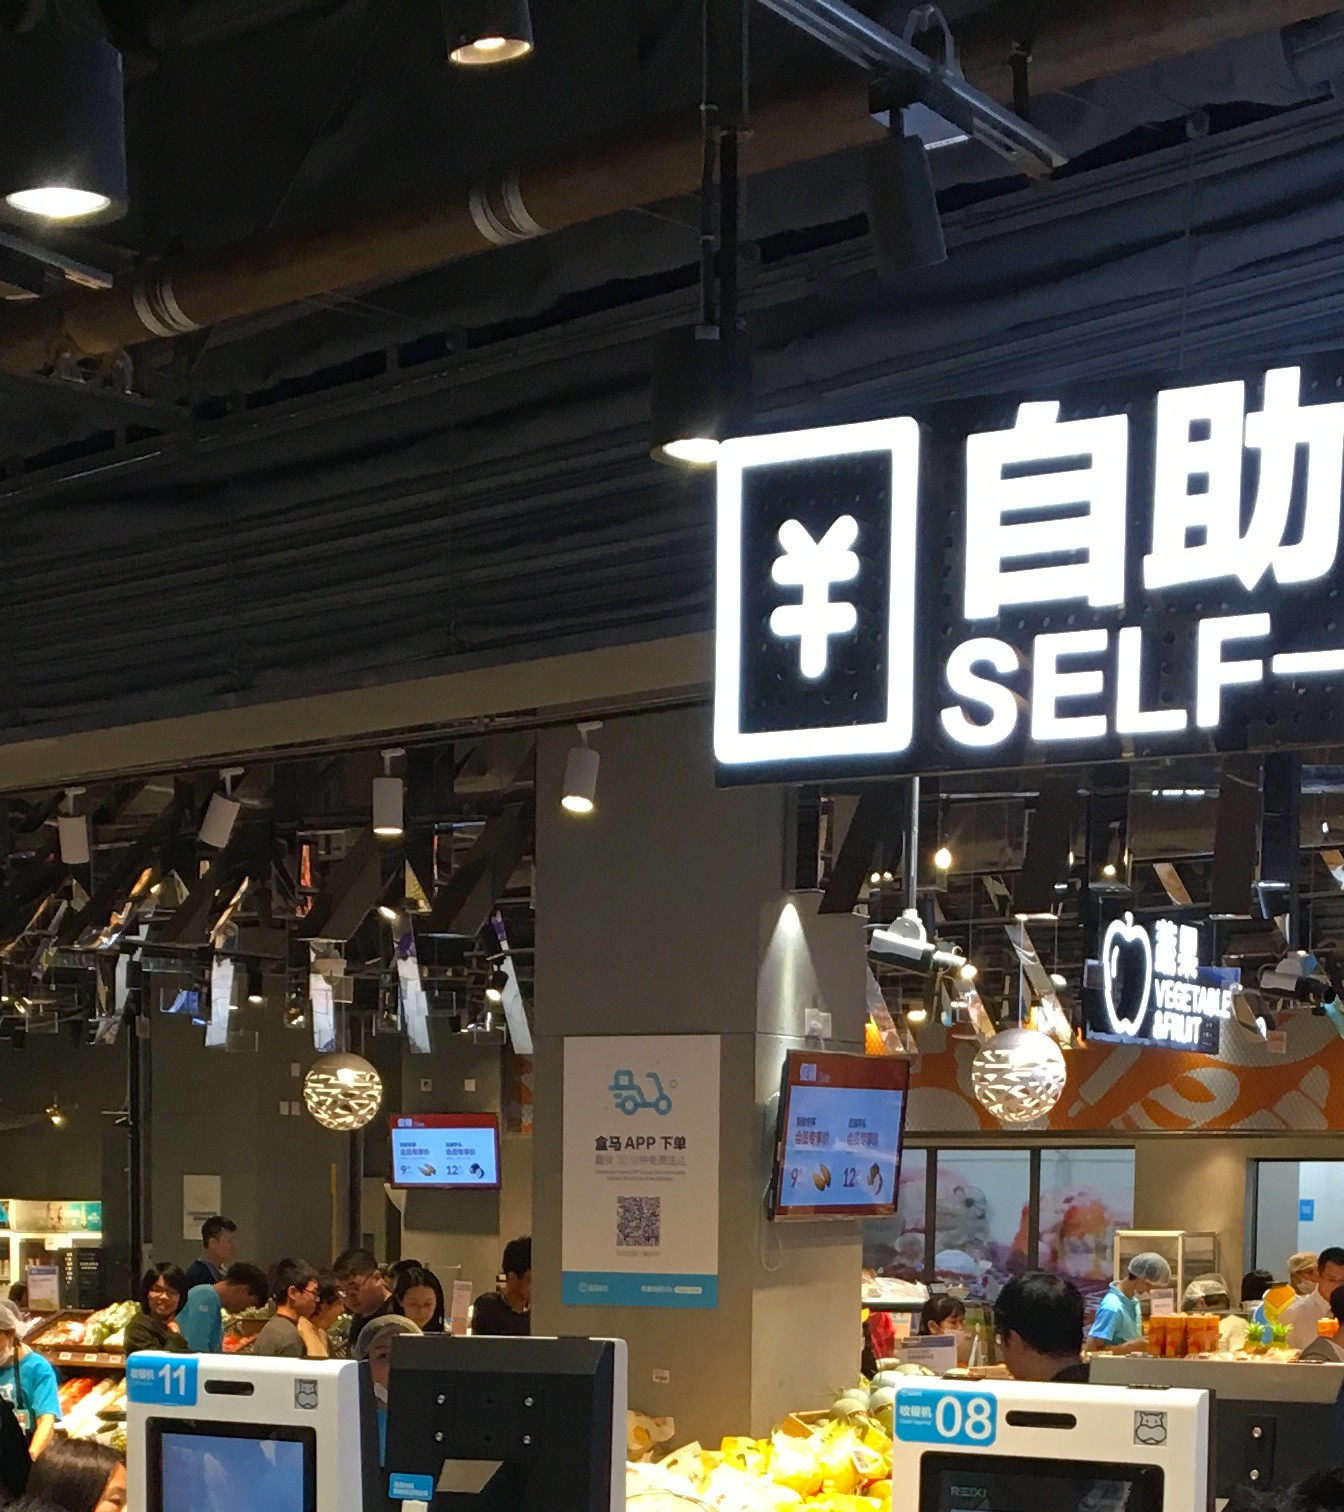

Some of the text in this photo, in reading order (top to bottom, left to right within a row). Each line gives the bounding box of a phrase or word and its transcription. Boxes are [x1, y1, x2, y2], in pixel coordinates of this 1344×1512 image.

[1155, 919, 1198, 979] 蔬果
[1155, 979, 1232, 1018] VEGETABLE
[1153, 1010, 1202, 1044] &FRUIT
[595, 1136, 687, 1151] 盒马 APP 下单
[400, 1164, 459, 1175] 9 12
[791, 1167, 856, 1188] 9 12
[158, 1363, 186, 1395] 11
[899, 1395, 992, 1440] 收银机 08
